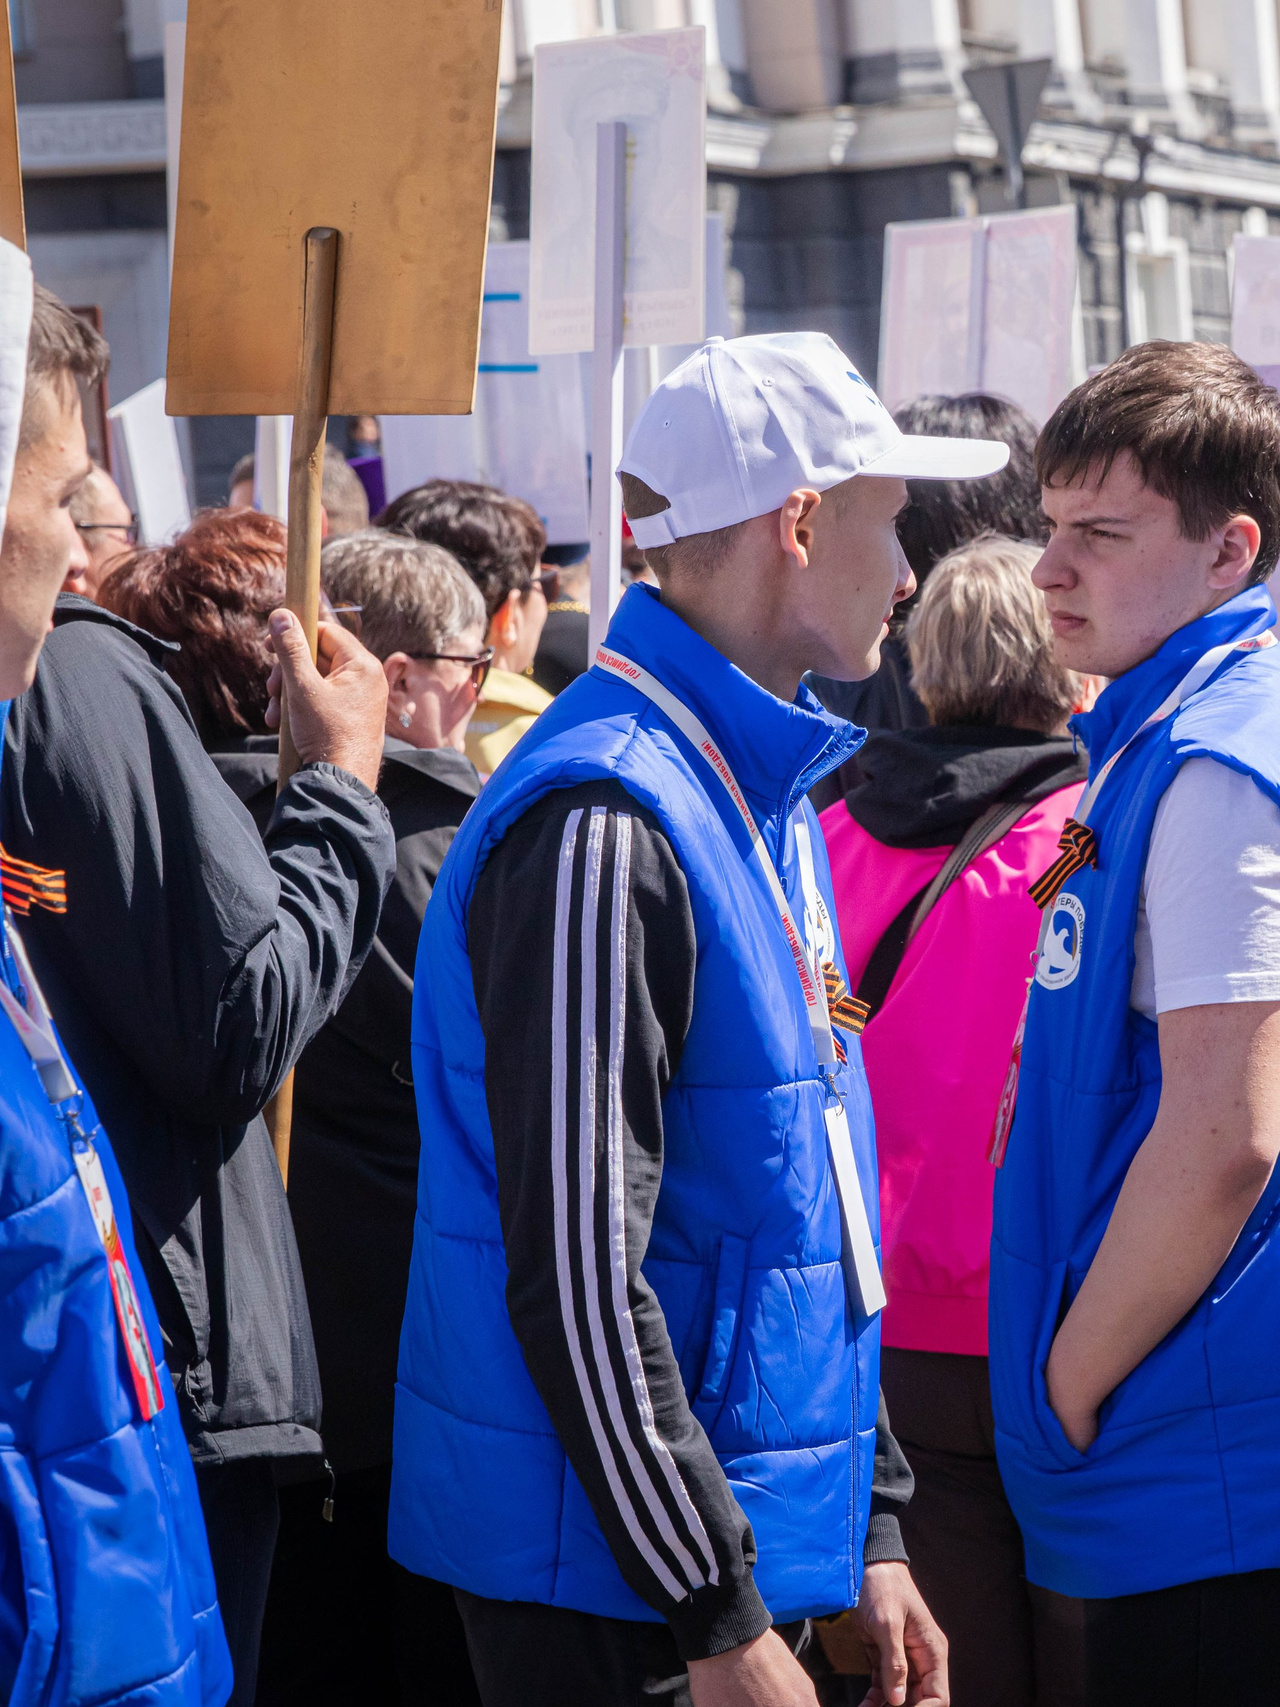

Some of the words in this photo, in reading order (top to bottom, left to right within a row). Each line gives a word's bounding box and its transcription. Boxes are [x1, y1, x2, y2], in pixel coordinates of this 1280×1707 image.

[701, 740, 732, 785] ПОБЕДОЙ!
[730, 784, 756, 834] ГОРДИМСЯ
[795, 957, 817, 1007] ГОРДИМСЯ
